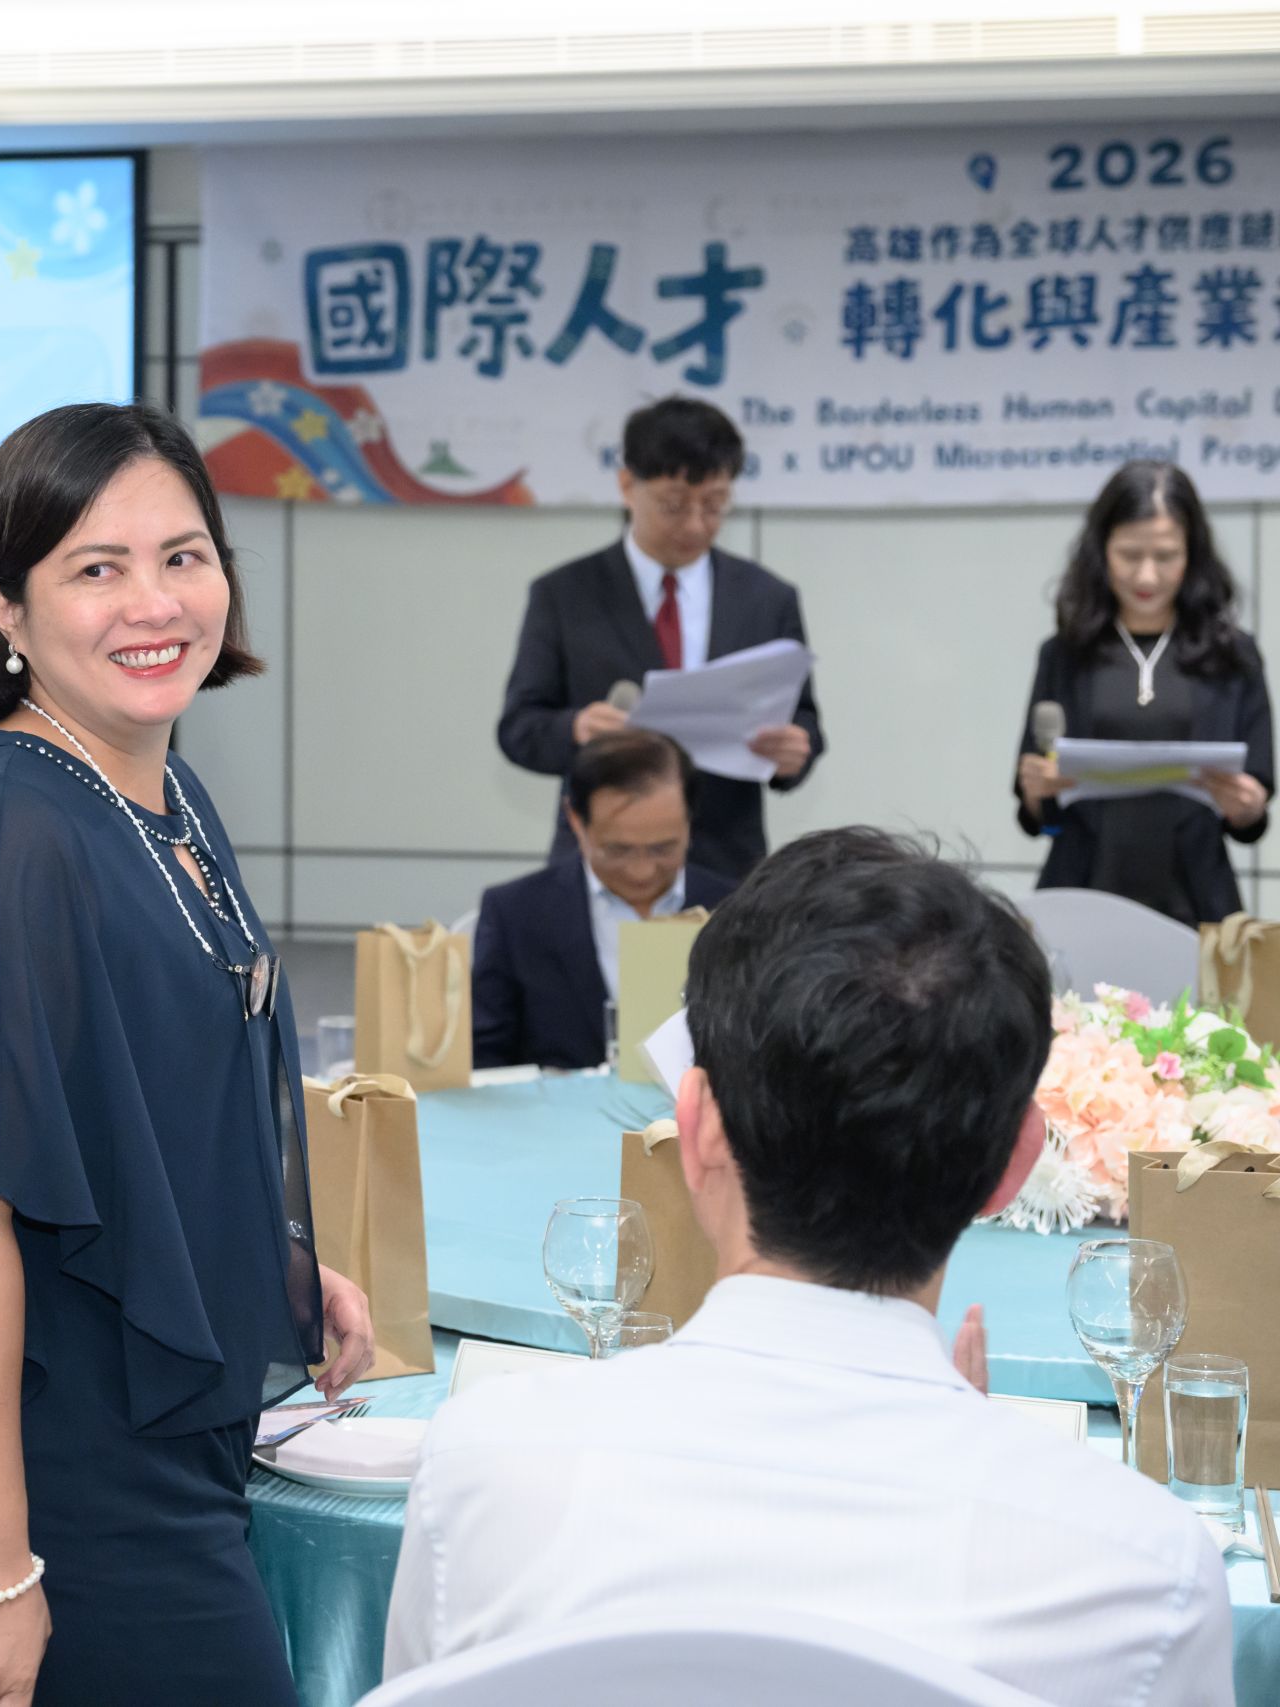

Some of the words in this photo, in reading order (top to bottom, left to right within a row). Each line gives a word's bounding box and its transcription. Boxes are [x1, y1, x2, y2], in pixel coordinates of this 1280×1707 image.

[1049, 137, 1236, 191] 2026
[305, 235, 765, 388] 國際人才
[842, 264, 1280, 361] 轉化與產業
[742, 398, 794, 424] The
[817, 396, 982, 426] Borderless
[1003, 392, 1114, 420] Human
[1135, 386, 1253, 424] Capital
[823, 442, 914, 472] UPOU
